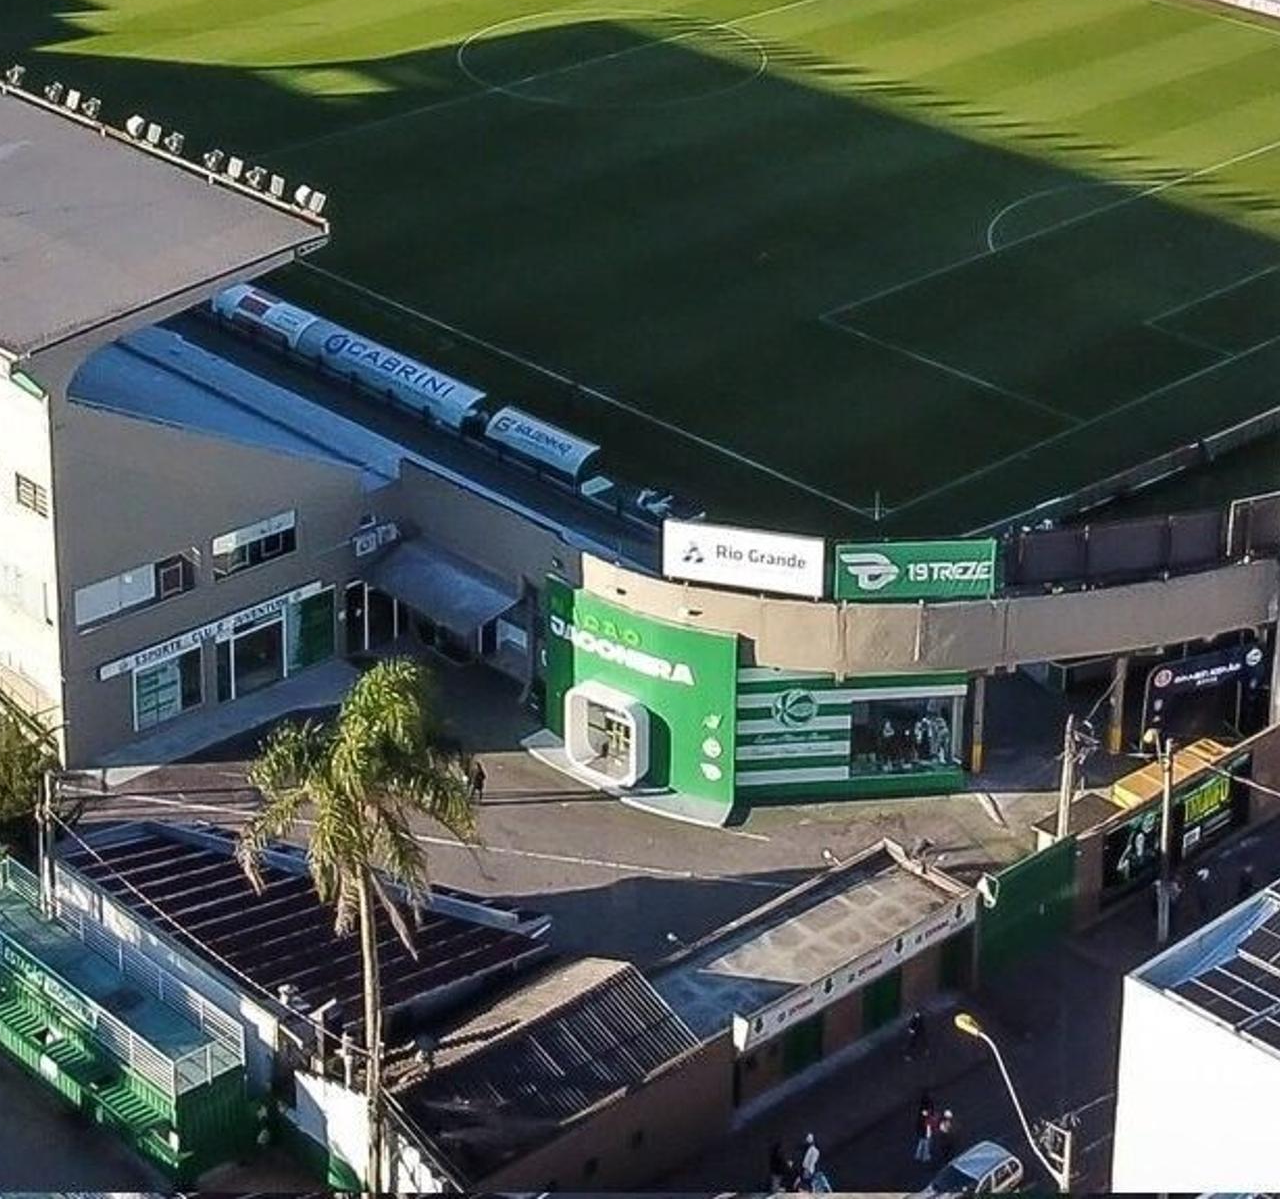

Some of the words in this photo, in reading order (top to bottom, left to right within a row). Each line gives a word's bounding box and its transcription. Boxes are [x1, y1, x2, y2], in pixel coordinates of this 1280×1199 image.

[347, 340, 457, 399] CABRINI
[716, 544, 743, 561] Rio
[749, 549, 807, 570] Grande
